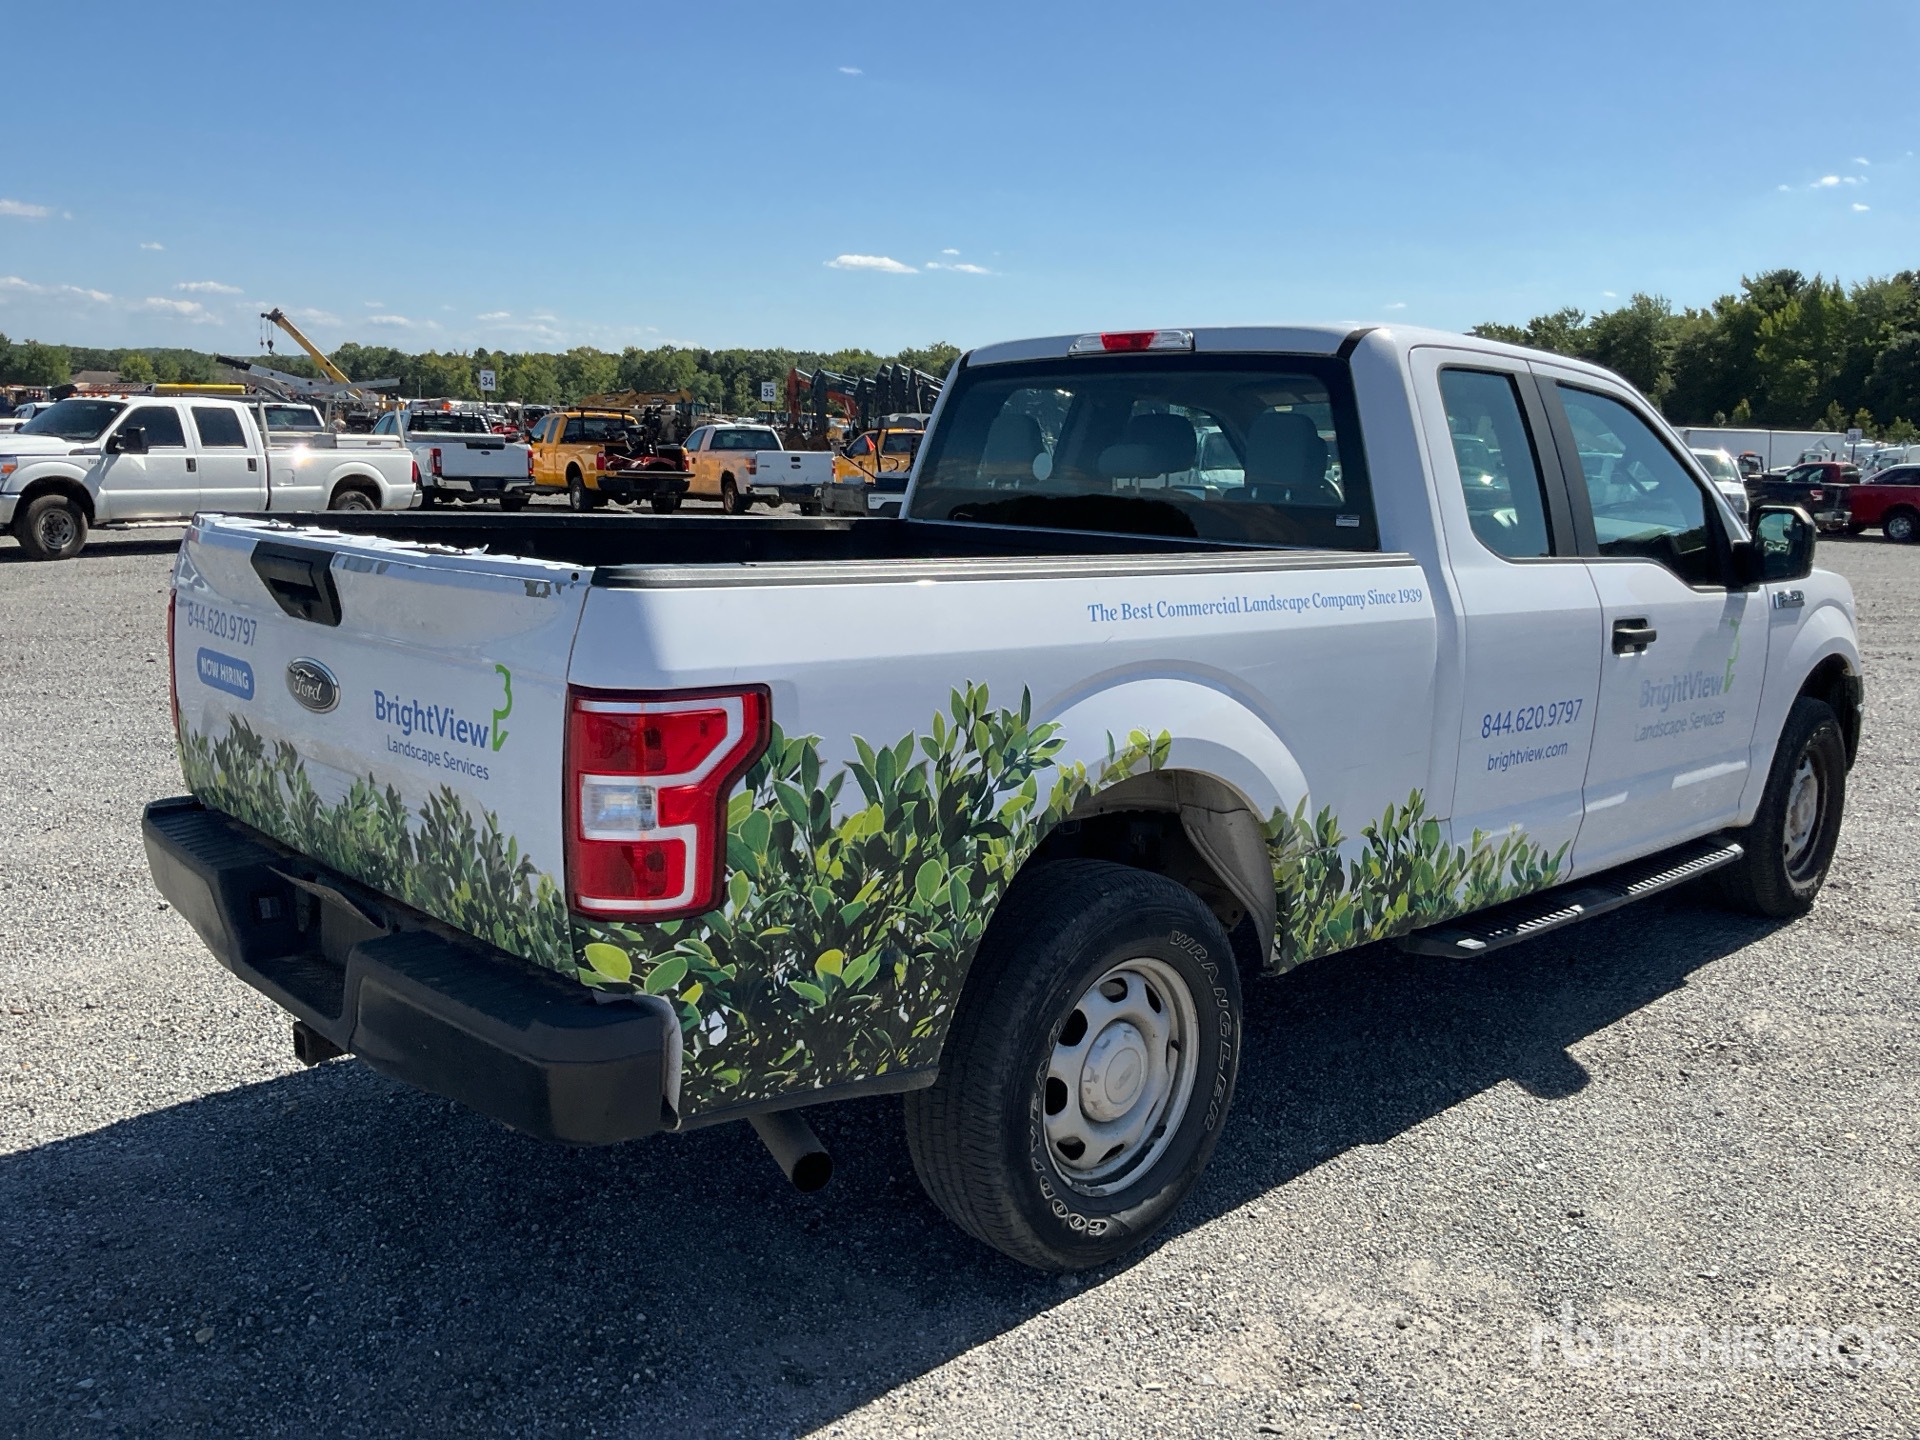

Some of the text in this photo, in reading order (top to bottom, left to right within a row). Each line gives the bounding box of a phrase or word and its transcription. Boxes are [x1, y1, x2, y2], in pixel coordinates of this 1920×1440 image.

[482, 376, 494, 386] 34
[763, 388, 775, 397] 35
[1087, 588, 1423, 622] The Best Commercial Landscape Company Since 1939
[187, 602, 257, 646] 844.620.9797
[201, 656, 249, 690] NOW HIRING
[291, 668, 323, 702] Ford
[1640, 670, 1723, 712] BrightView
[374, 689, 489, 749] BrightView
[1481, 699, 1583, 738] 844.620.9797
[1634, 708, 1725, 743] Landscape Services
[387, 734, 489, 780] Landscape Services
[1487, 742, 1568, 771] brightview.com
[1169, 930, 1232, 1131] WRANGLER
